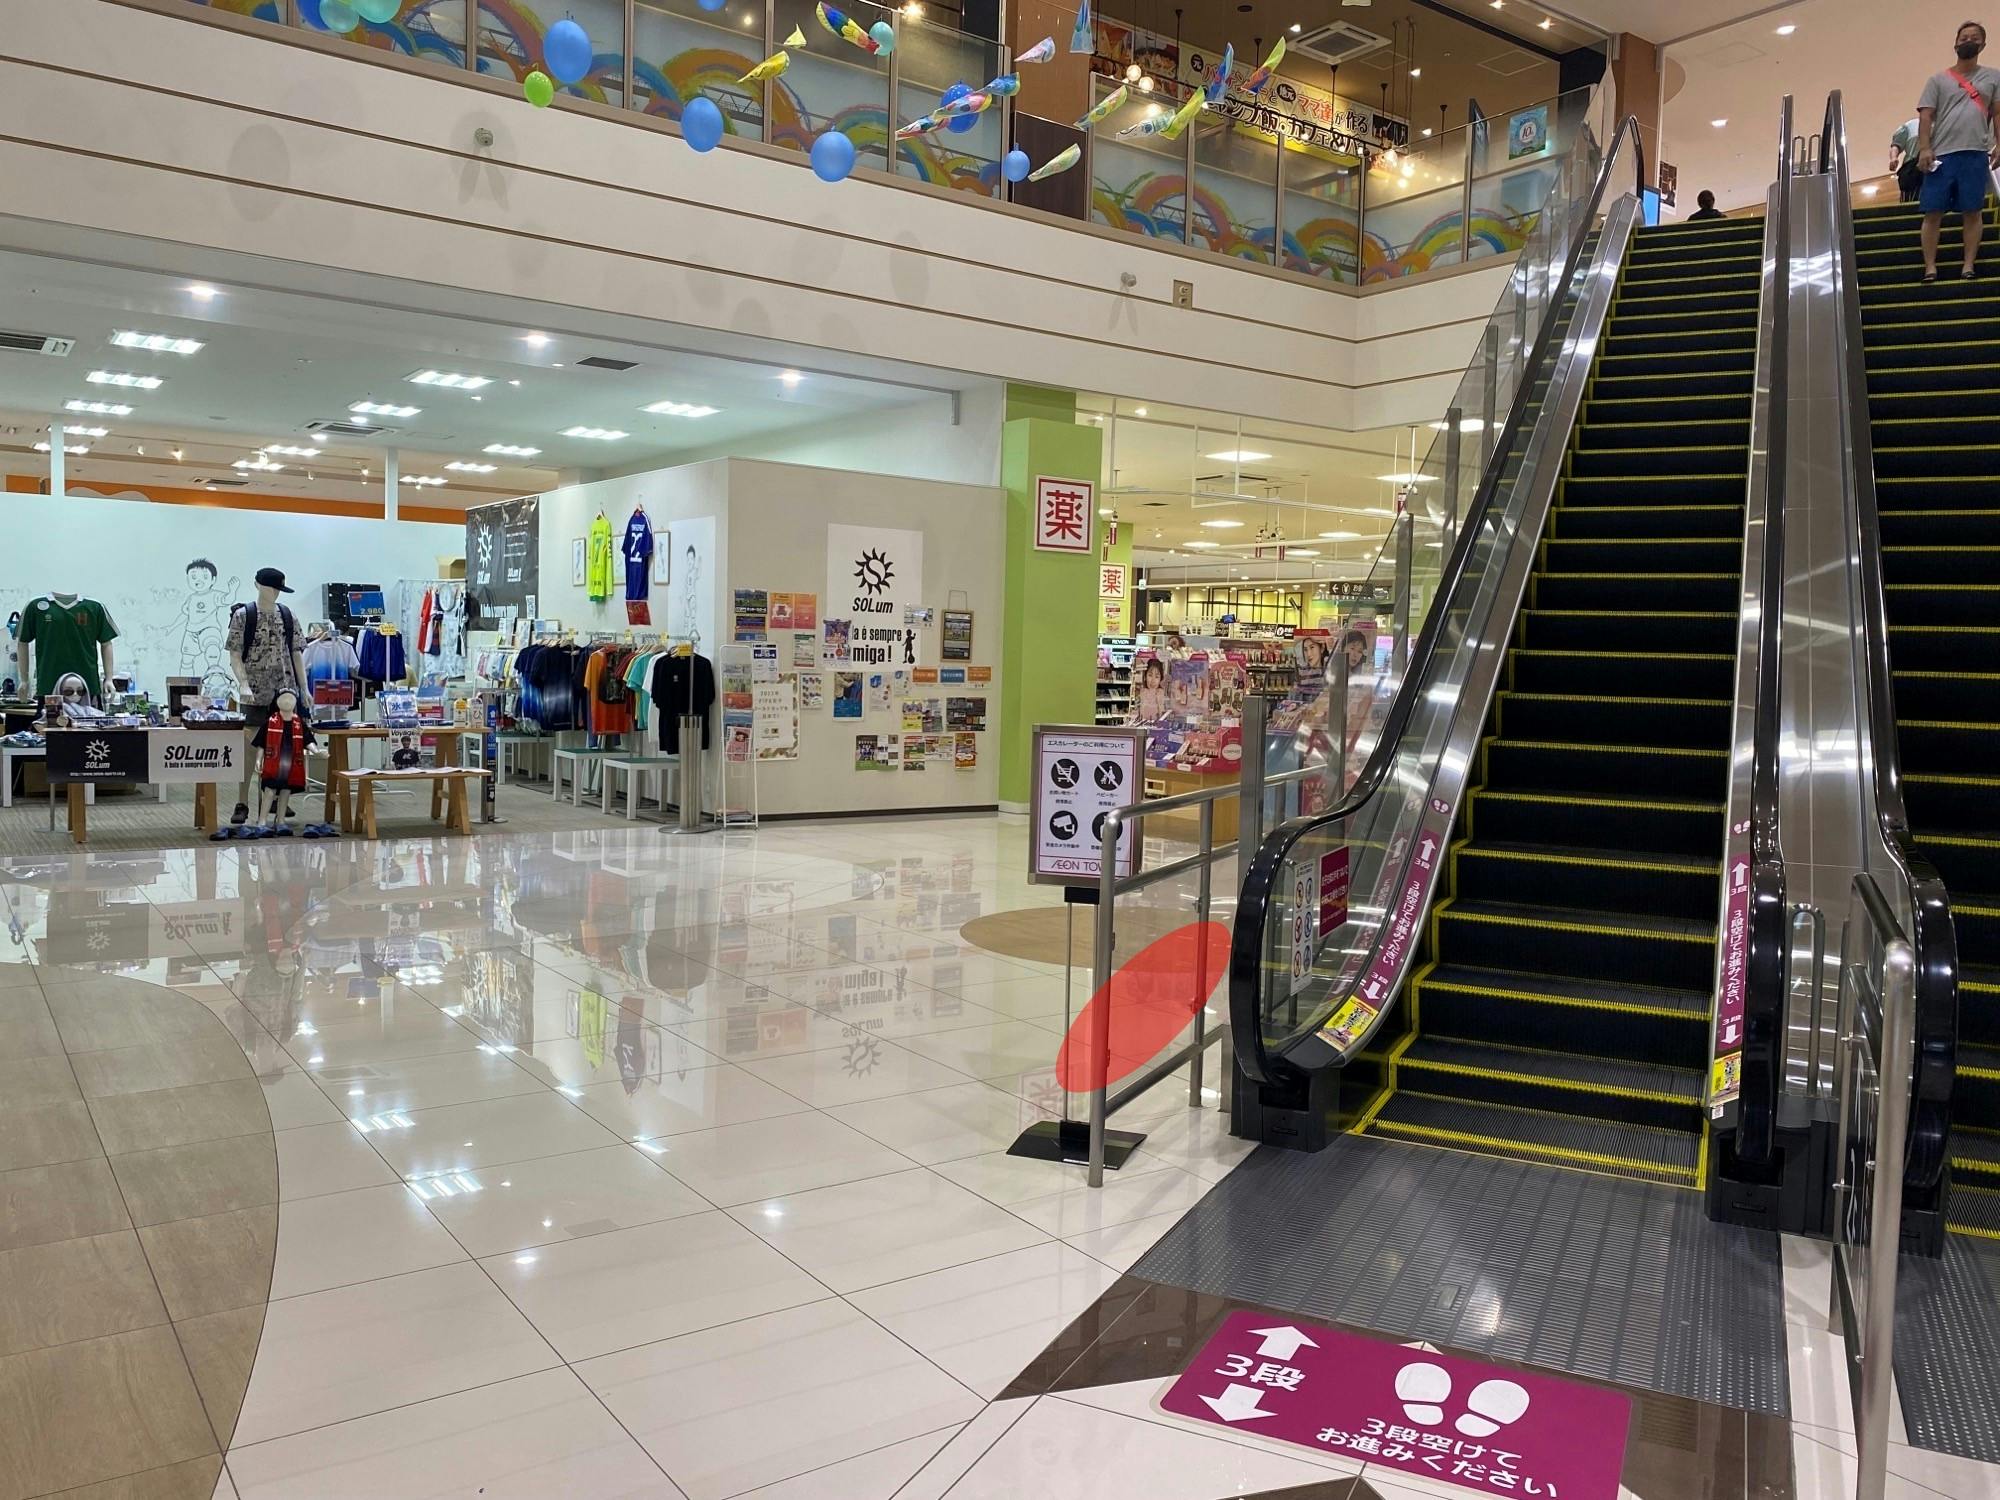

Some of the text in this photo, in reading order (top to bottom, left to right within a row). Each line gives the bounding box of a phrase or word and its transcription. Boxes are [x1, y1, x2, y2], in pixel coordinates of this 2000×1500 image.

[1045, 490, 1084, 540] 薬
[1102, 568, 1122, 594] 薬
[852, 596, 894, 613] SOLum
[861, 624, 867, 640] é
[869, 628, 902, 643] sempre
[84, 761, 110, 769] SOLum
[164, 745, 219, 760] SOLum
[1213, 1353, 1307, 1392] 3段
[1360, 1417, 1523, 1470] 3段空けて
[1315, 1427, 1559, 1499] お進みください
